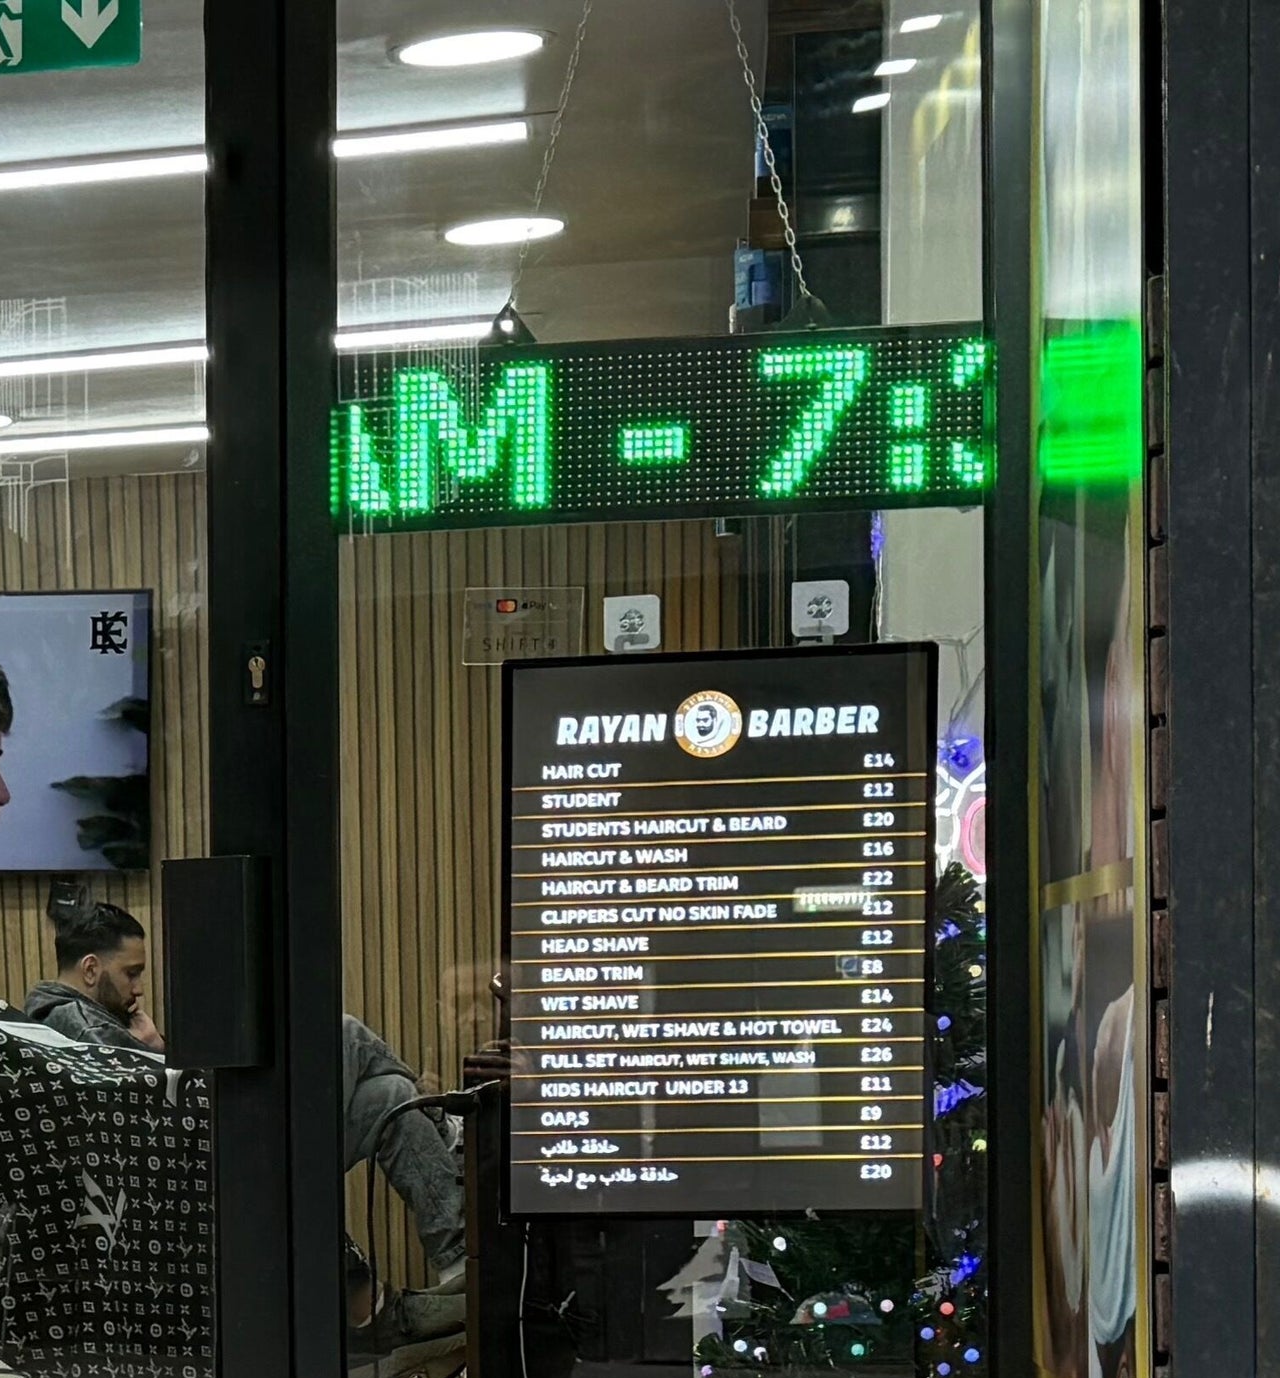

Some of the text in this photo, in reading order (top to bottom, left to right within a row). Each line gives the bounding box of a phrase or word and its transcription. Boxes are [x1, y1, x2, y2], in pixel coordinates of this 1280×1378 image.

[556, 714, 667, 745] RAYAN
[748, 705, 879, 737] BARBER
[542, 754, 894, 780] HAIR CUT £14
[542, 783, 893, 809] STUDENT £12
[542, 812, 894, 838] STUDENTS HAIRCUT & BEARD £20
[542, 842, 894, 867] HAIRCUT & WASH £16
[542, 871, 893, 896] HAIRCUT & BEARD TRIM £22
[541, 900, 893, 925] CLIPPERS CUT NO SKIN FADE £12
[541, 930, 893, 953] HEAD SHAVE £12
[541, 959, 883, 982] BEARD TRIM £8
[541, 989, 893, 1011] WET SHAVE £14
[541, 1018, 892, 1040] HAIRCUT, WET SHAVE & HOT TOWEL £24
[541, 1047, 892, 1068] FULL SET HAIRCUT, WET SHAVE, WASH £26
[541, 1076, 892, 1097] KIDS HAIRCUT UNDER 13 £11
[861, 1106, 882, 1120] £9
[861, 1135, 891, 1150] £12
[860, 1164, 892, 1179] £20
